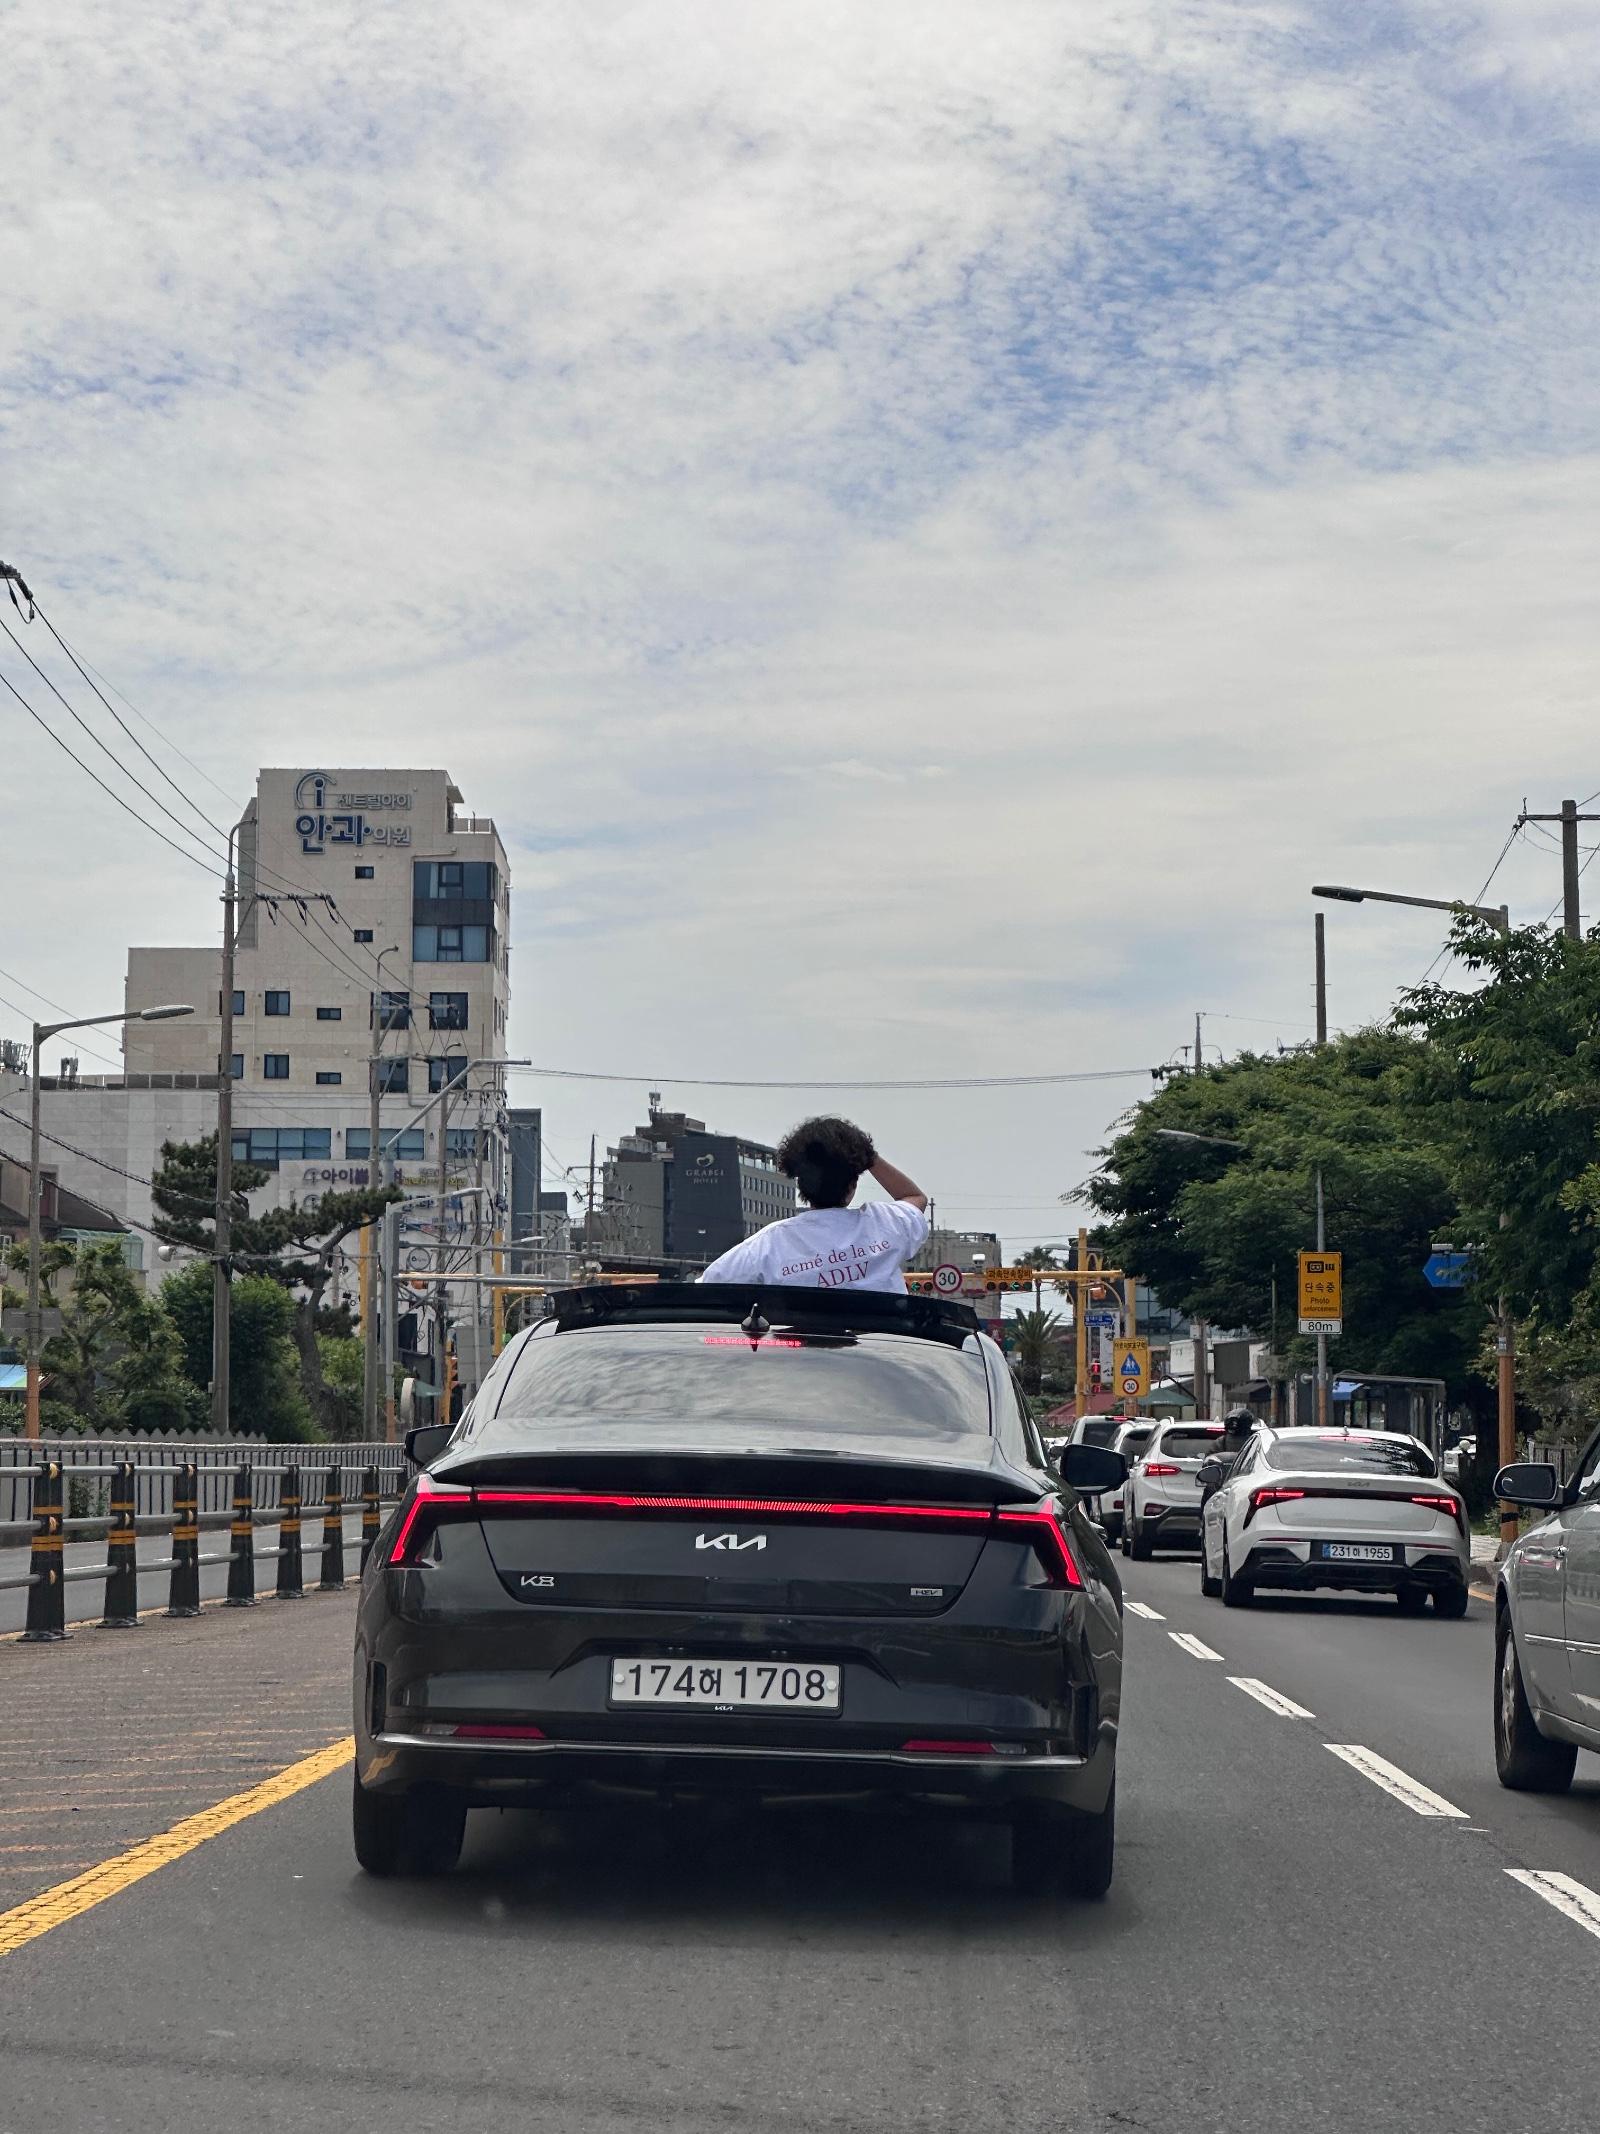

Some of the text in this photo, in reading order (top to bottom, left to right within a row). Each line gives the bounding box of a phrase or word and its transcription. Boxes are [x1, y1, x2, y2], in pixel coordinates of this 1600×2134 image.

[782, 1240, 890, 1276] acmé de la vie
[817, 1261, 868, 1288] ADLV
[939, 1272, 956, 1286] 30
[987, 1268, 1032, 1279] 과속단속장비
[1310, 1297, 1330, 1305] Photo
[1308, 1321, 1333, 1332] 80m
[1126, 1383, 1136, 1391] 30
[520, 1575, 555, 1587] K8
[734, 1666, 826, 1701] 1708
